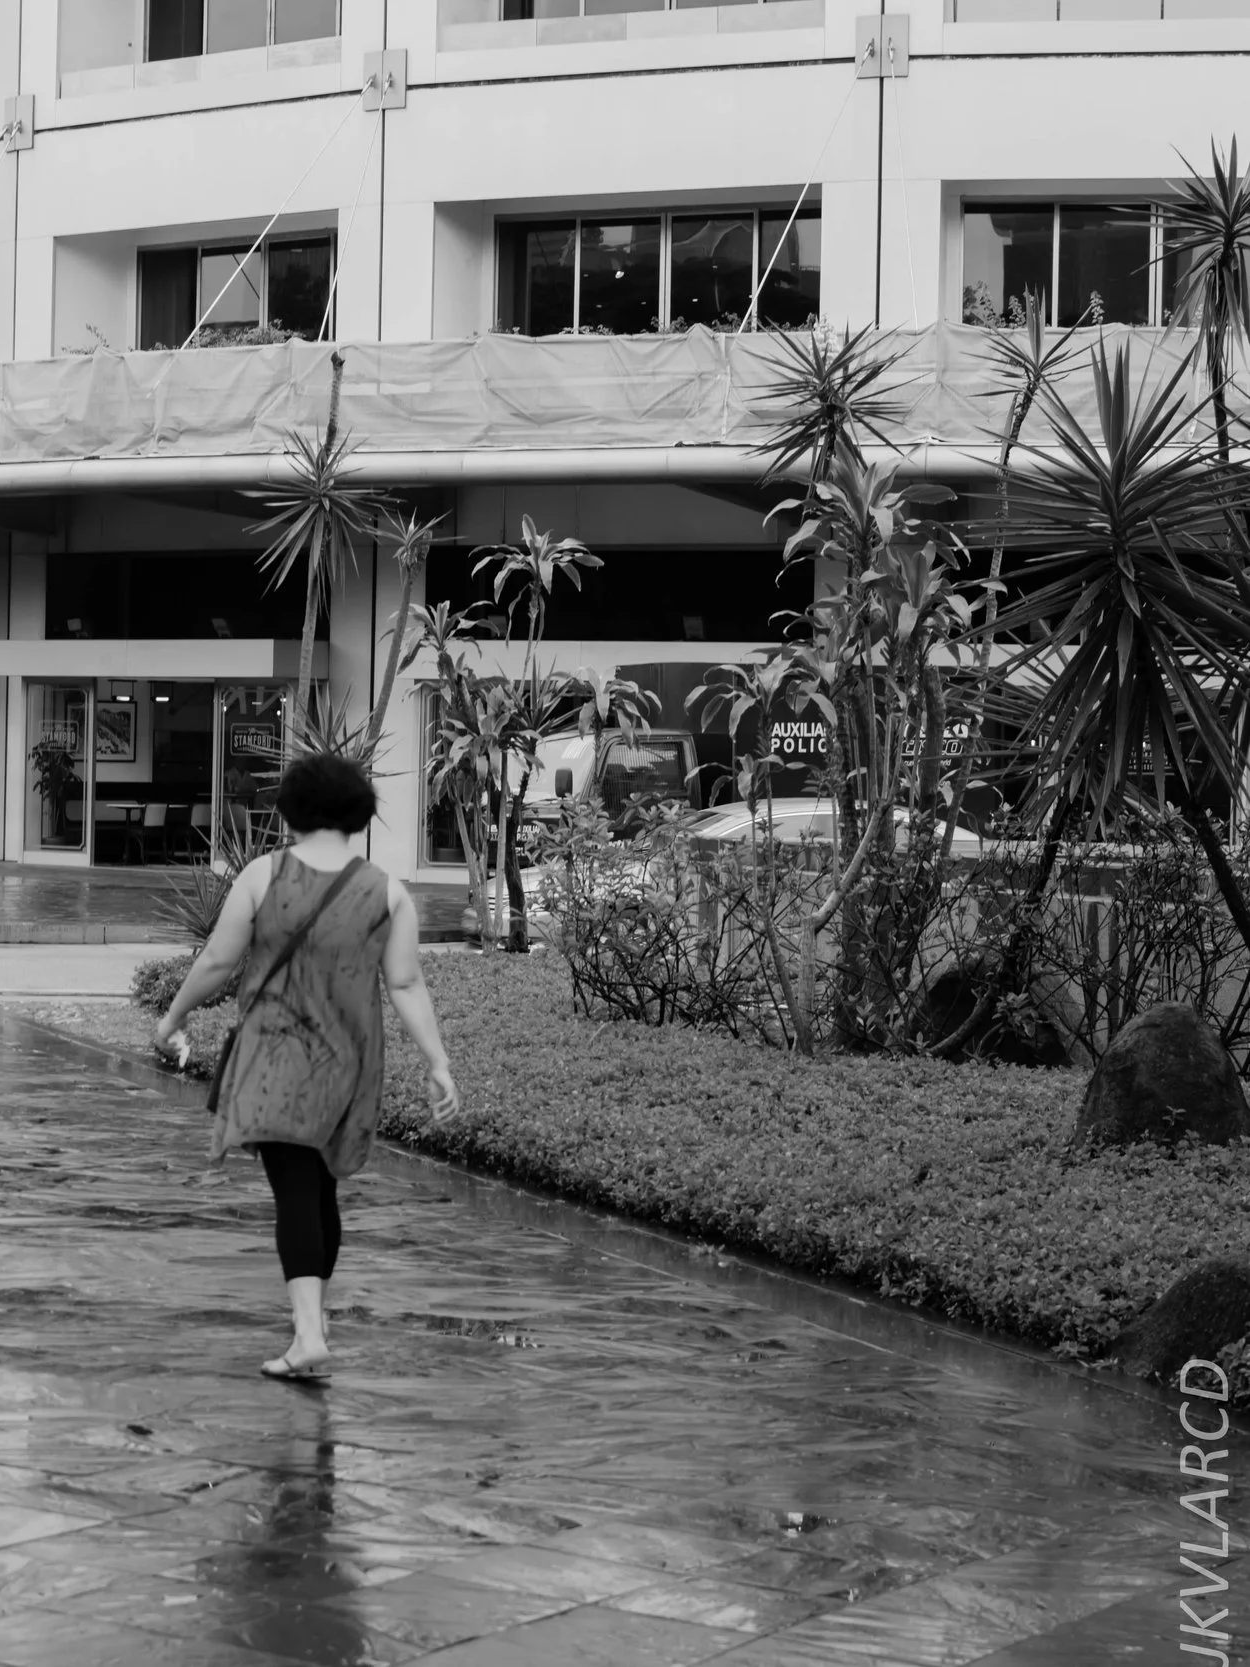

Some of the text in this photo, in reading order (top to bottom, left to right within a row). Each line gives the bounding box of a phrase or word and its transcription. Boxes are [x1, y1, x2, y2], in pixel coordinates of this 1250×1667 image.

[771, 722, 826, 737] AUXILIA
[234, 734, 271, 748] STAMFORD
[771, 738, 827, 753] POLIC
